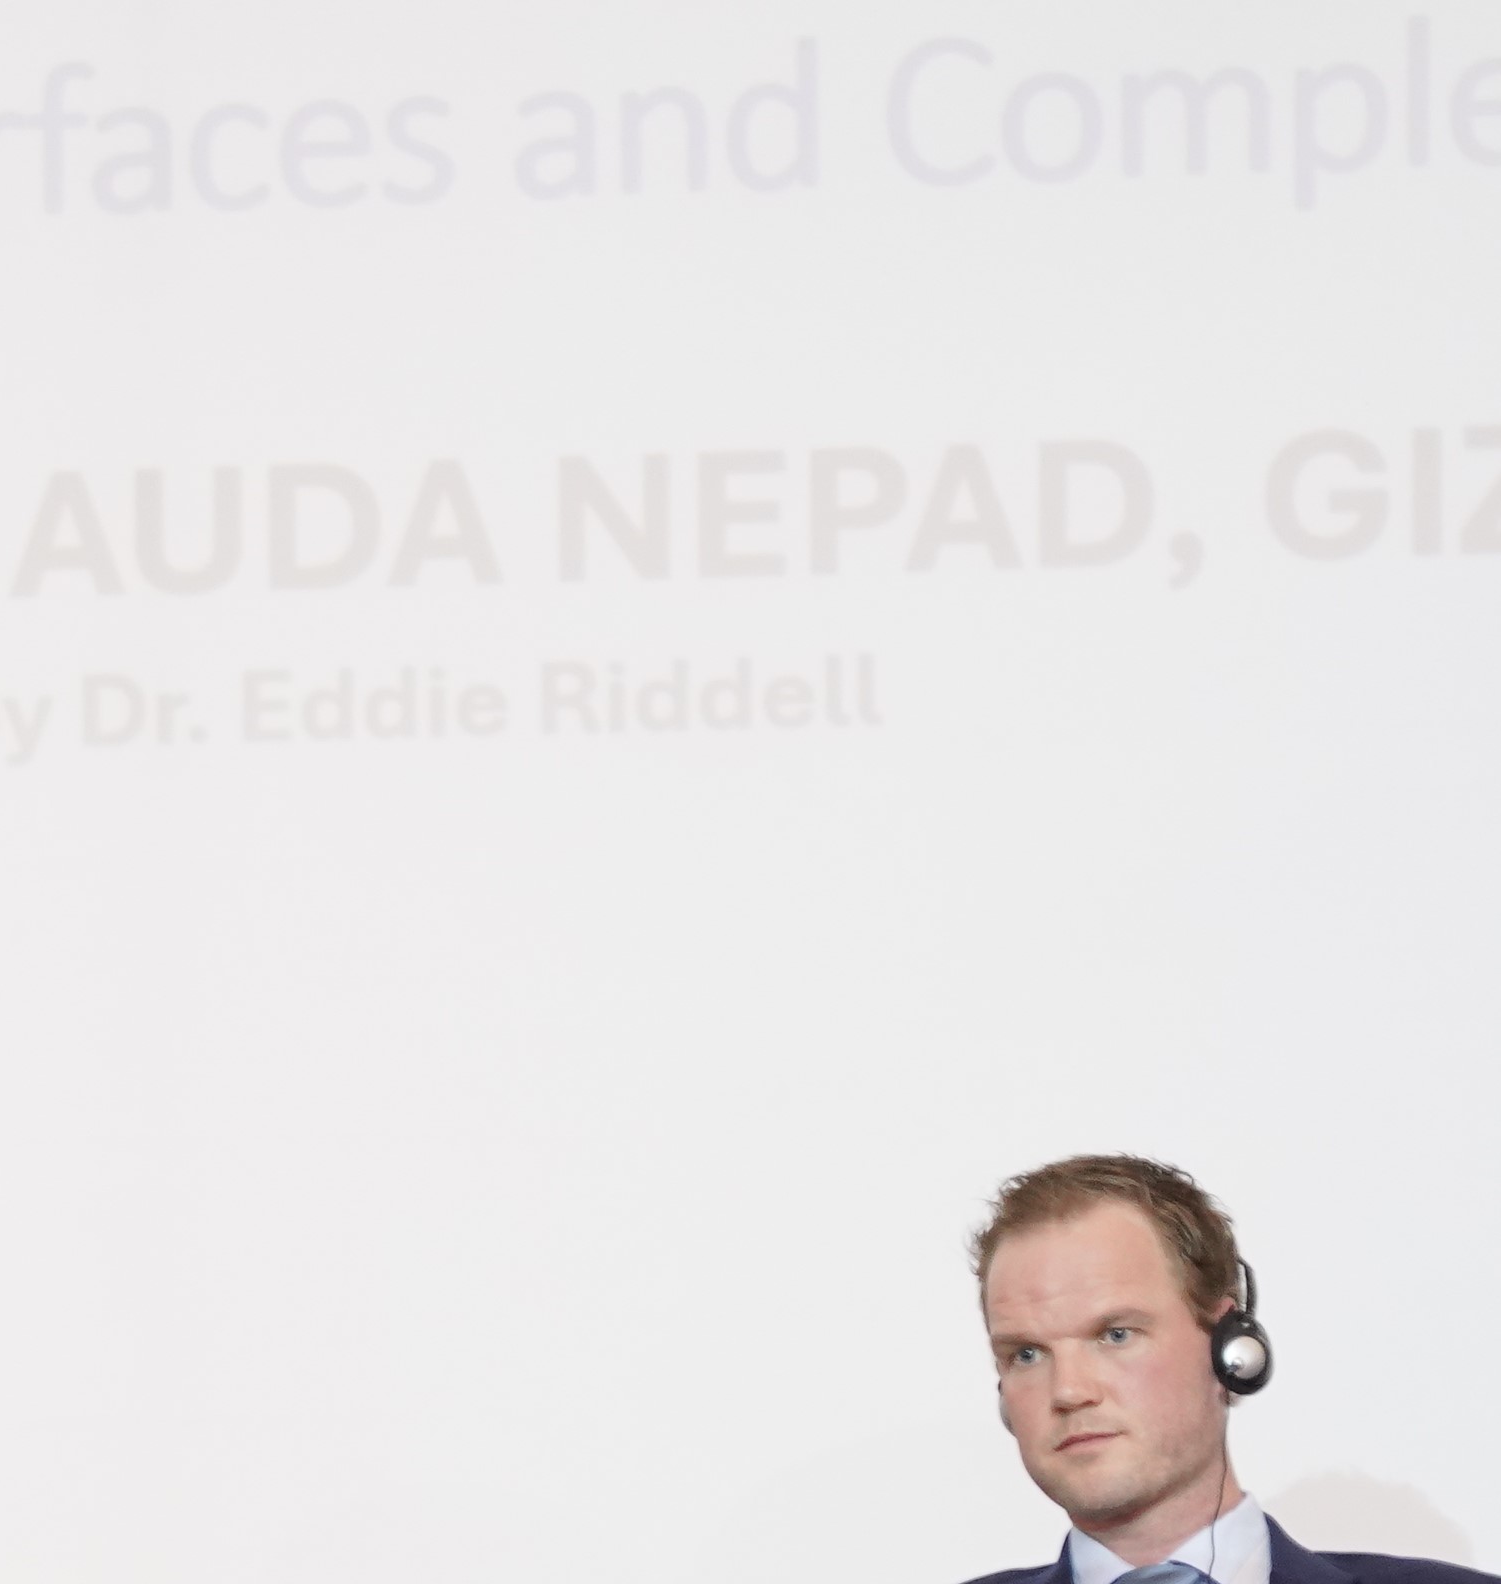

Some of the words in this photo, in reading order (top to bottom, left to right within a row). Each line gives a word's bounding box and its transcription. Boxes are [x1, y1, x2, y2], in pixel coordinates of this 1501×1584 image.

[513, 35, 821, 201] and
[884, 13, 1501, 211] Comple
[9, 458, 504, 598] AUDA
[557, 438, 1206, 591] NEPAD,
[80, 672, 209, 748] Dr.
[240, 664, 510, 743] Eddie
[539, 651, 885, 737] Riddell
